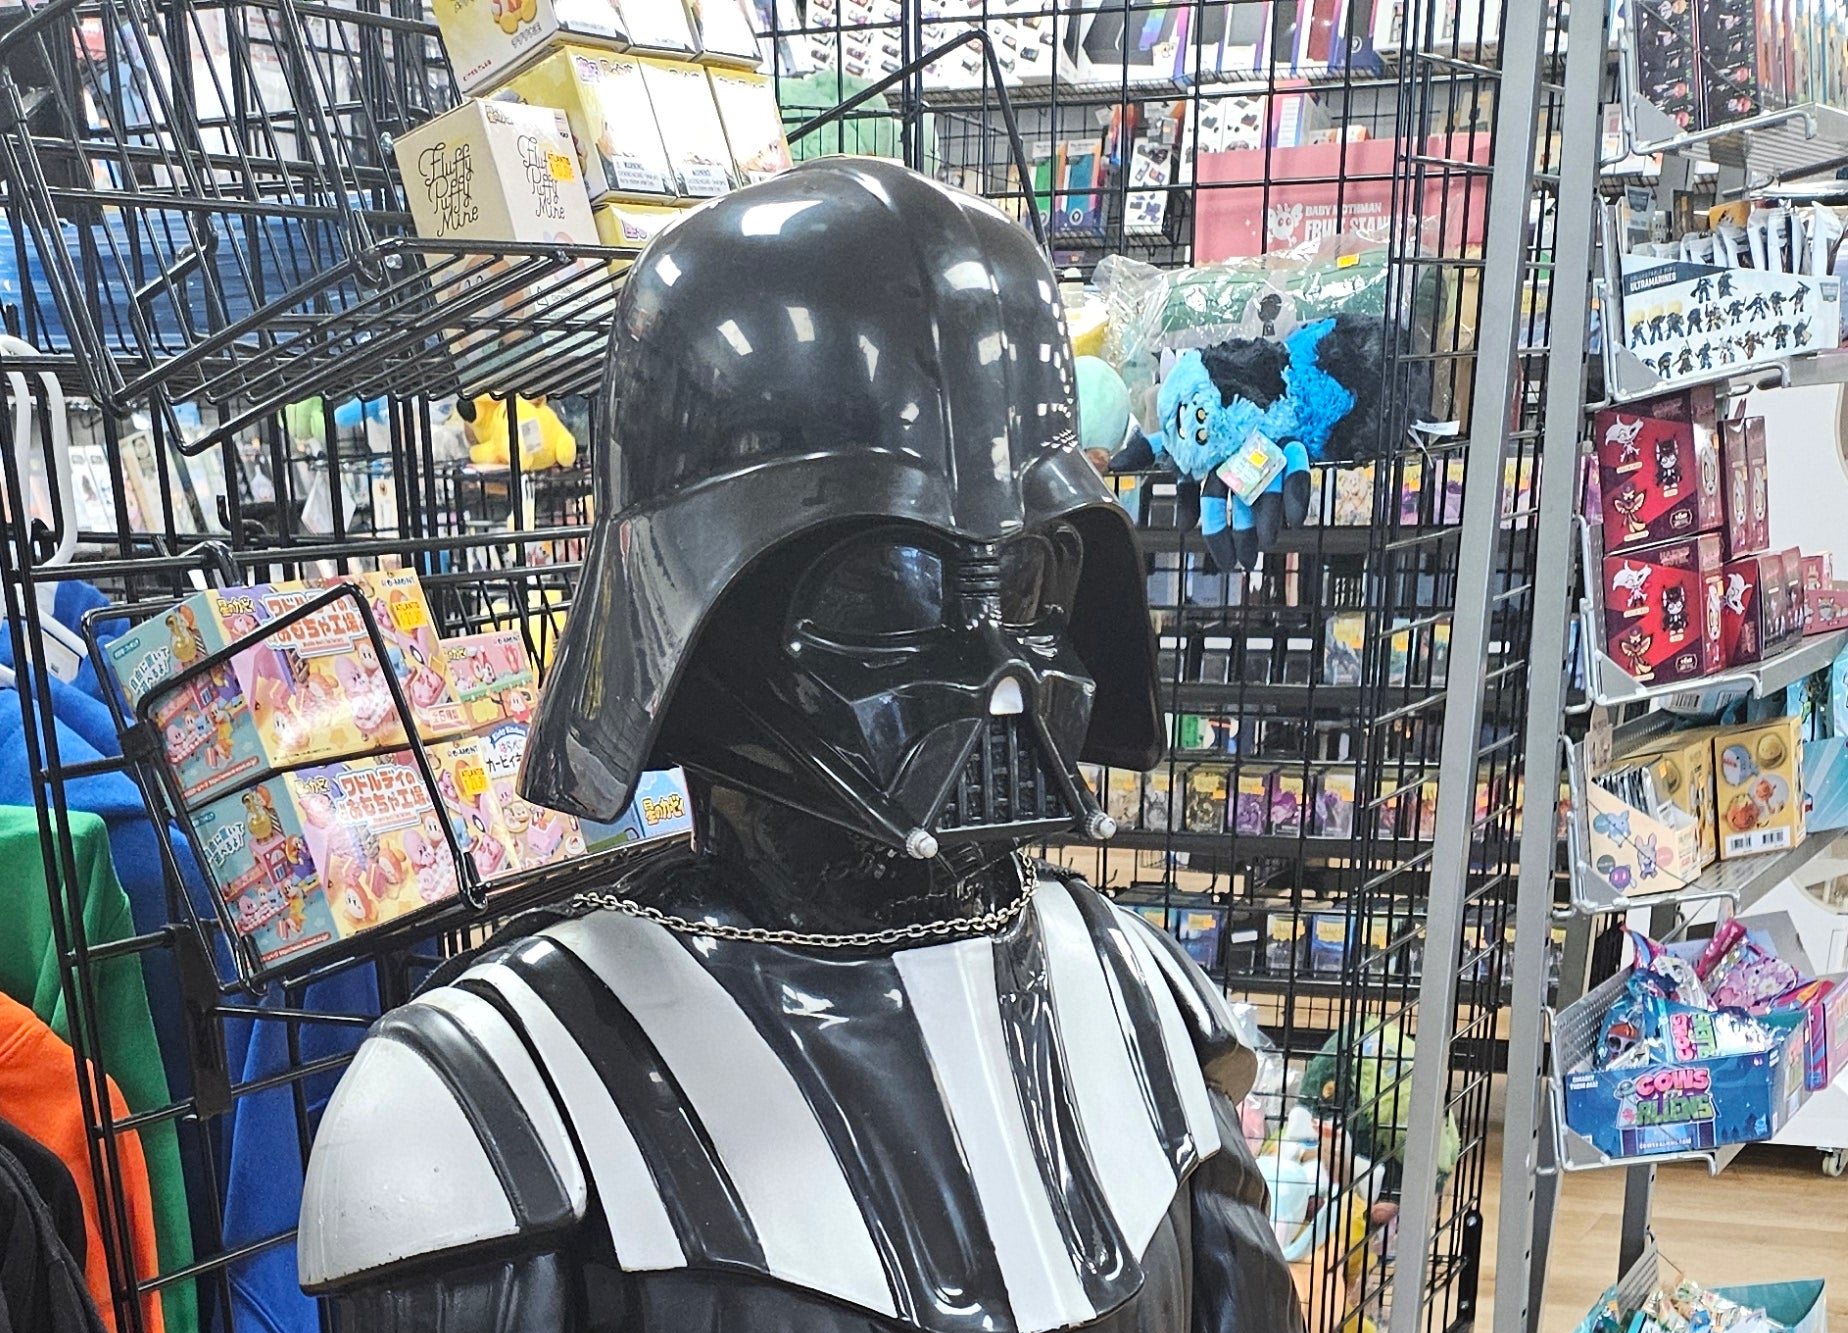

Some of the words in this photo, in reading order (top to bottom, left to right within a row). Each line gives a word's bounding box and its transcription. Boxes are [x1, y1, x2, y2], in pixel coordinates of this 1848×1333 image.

[437, 205, 479, 237] Mine
[536, 196, 566, 219] Mine
[1305, 205, 1332, 217] BABY
[1350, 215, 1392, 236] STAN
[1630, 271, 1677, 291] ULTRAMARINES
[340, 770, 415, 797] ワドルディの
[346, 784, 427, 820] おもちゃ工場
[1635, 1068, 1709, 1097] COWS
[1636, 1094, 1714, 1127] ALIENS
